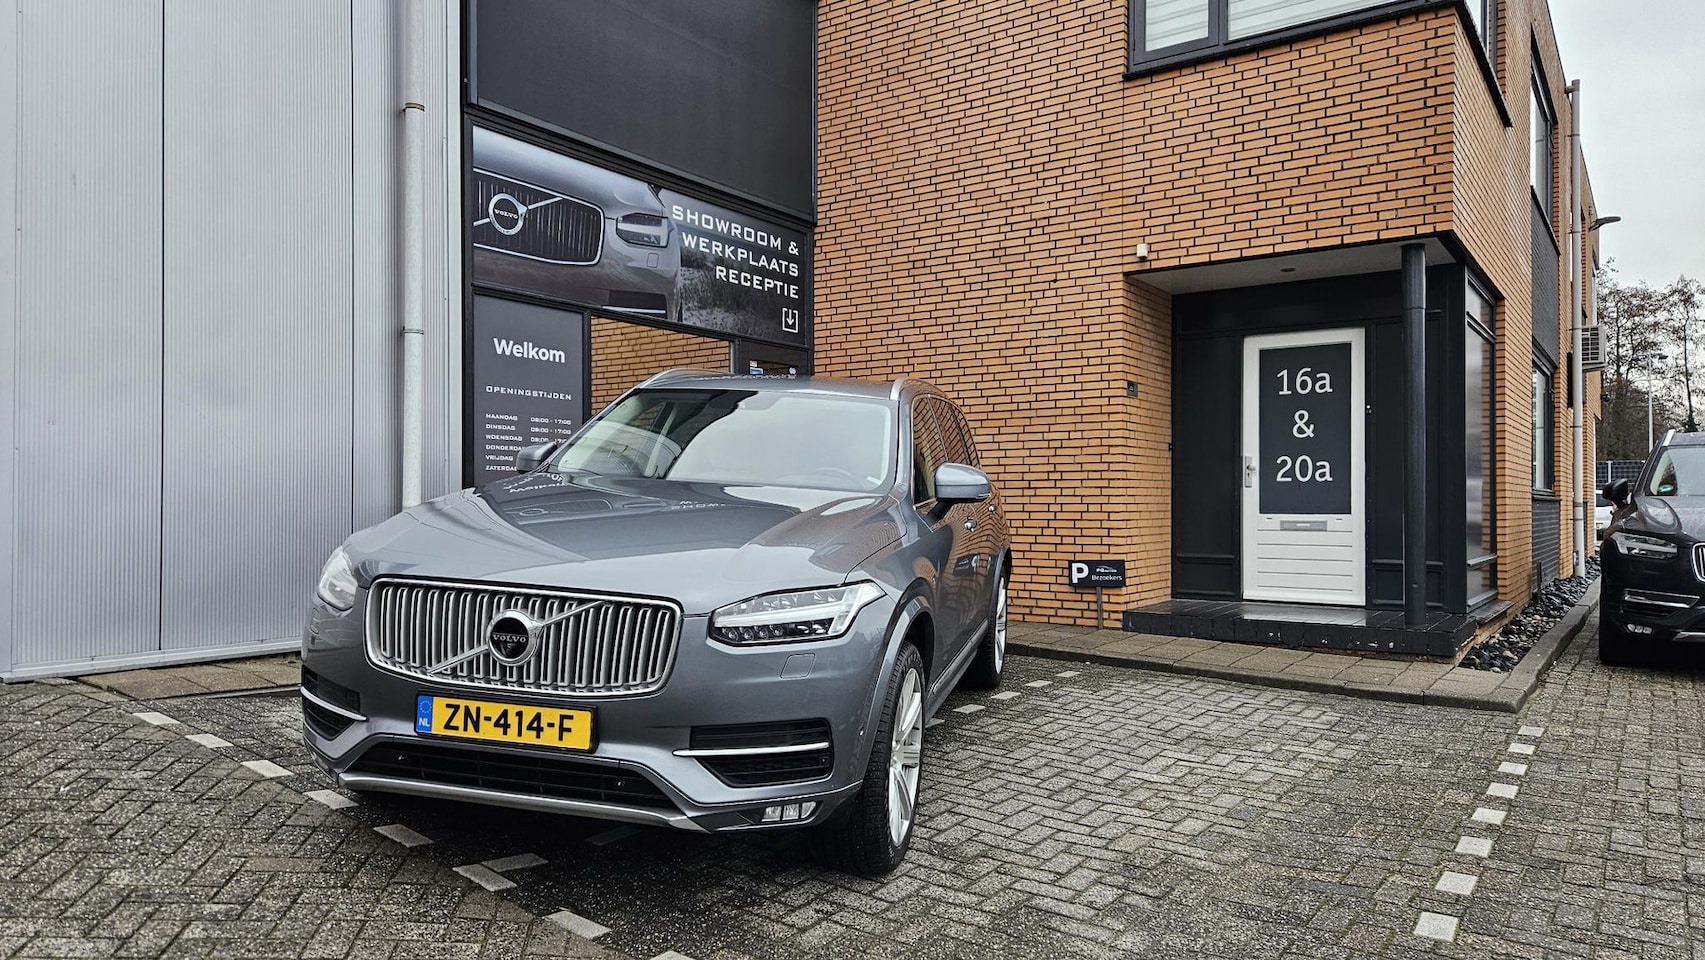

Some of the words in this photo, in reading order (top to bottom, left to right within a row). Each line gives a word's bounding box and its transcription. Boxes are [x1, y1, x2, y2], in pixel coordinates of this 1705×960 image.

[494, 208, 519, 219] VOLVO
[672, 205, 782, 251] SHOWROOM
[788, 241, 799, 255] &
[682, 232, 799, 277] WERKPLAATS
[716, 265, 799, 299] RECEPTIE
[493, 337, 566, 363] Welkom
[486, 385, 572, 400] OPENINGSTIJDEN
[1276, 368, 1333, 396] 16a
[485, 413, 518, 421] MAANDAG
[1292, 410, 1315, 438] &
[485, 434, 523, 442] WOENSDAG
[1275, 455, 1333, 482] 20a
[1071, 562, 1089, 584] P
[492, 634, 527, 643] VOLVO
[419, 717, 431, 727] NL
[443, 703, 575, 742] ZN-414-F
